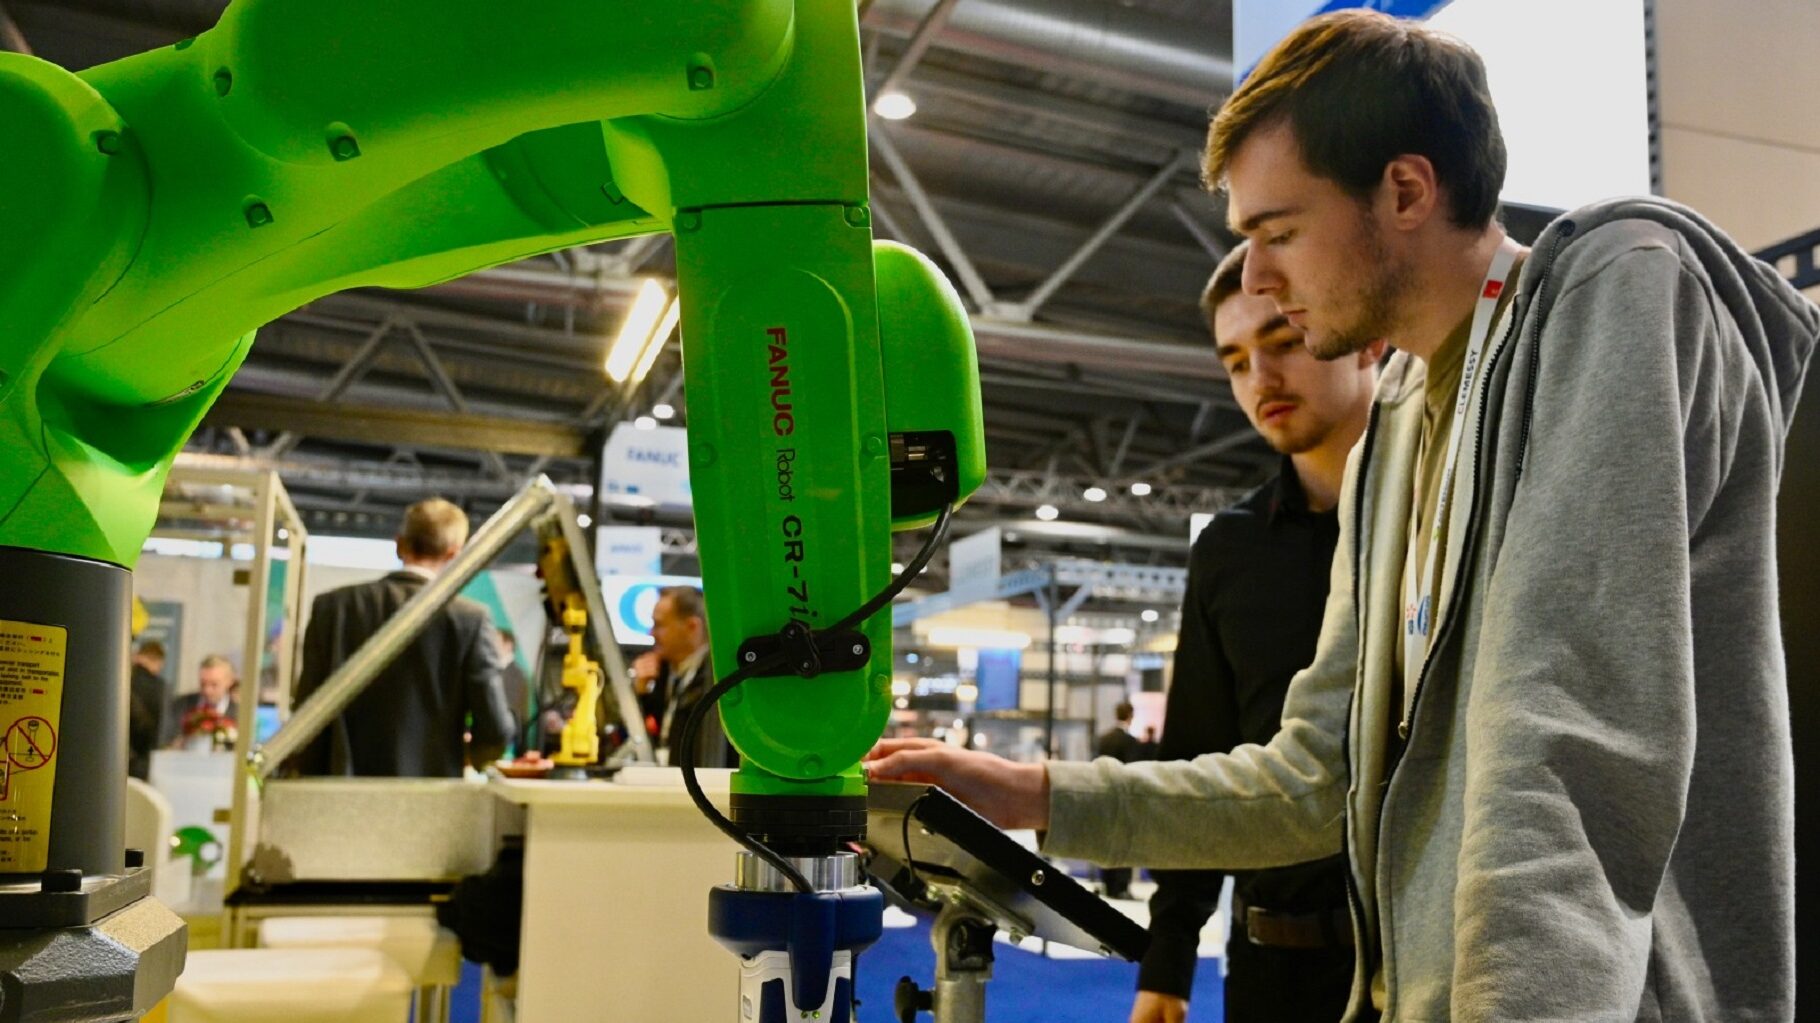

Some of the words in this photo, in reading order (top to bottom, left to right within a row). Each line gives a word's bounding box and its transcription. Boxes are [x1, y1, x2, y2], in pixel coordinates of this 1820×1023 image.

[767, 328, 795, 437] FANUC
[1457, 349, 1480, 415] CLEMESSY
[776, 448, 796, 502] Robot
